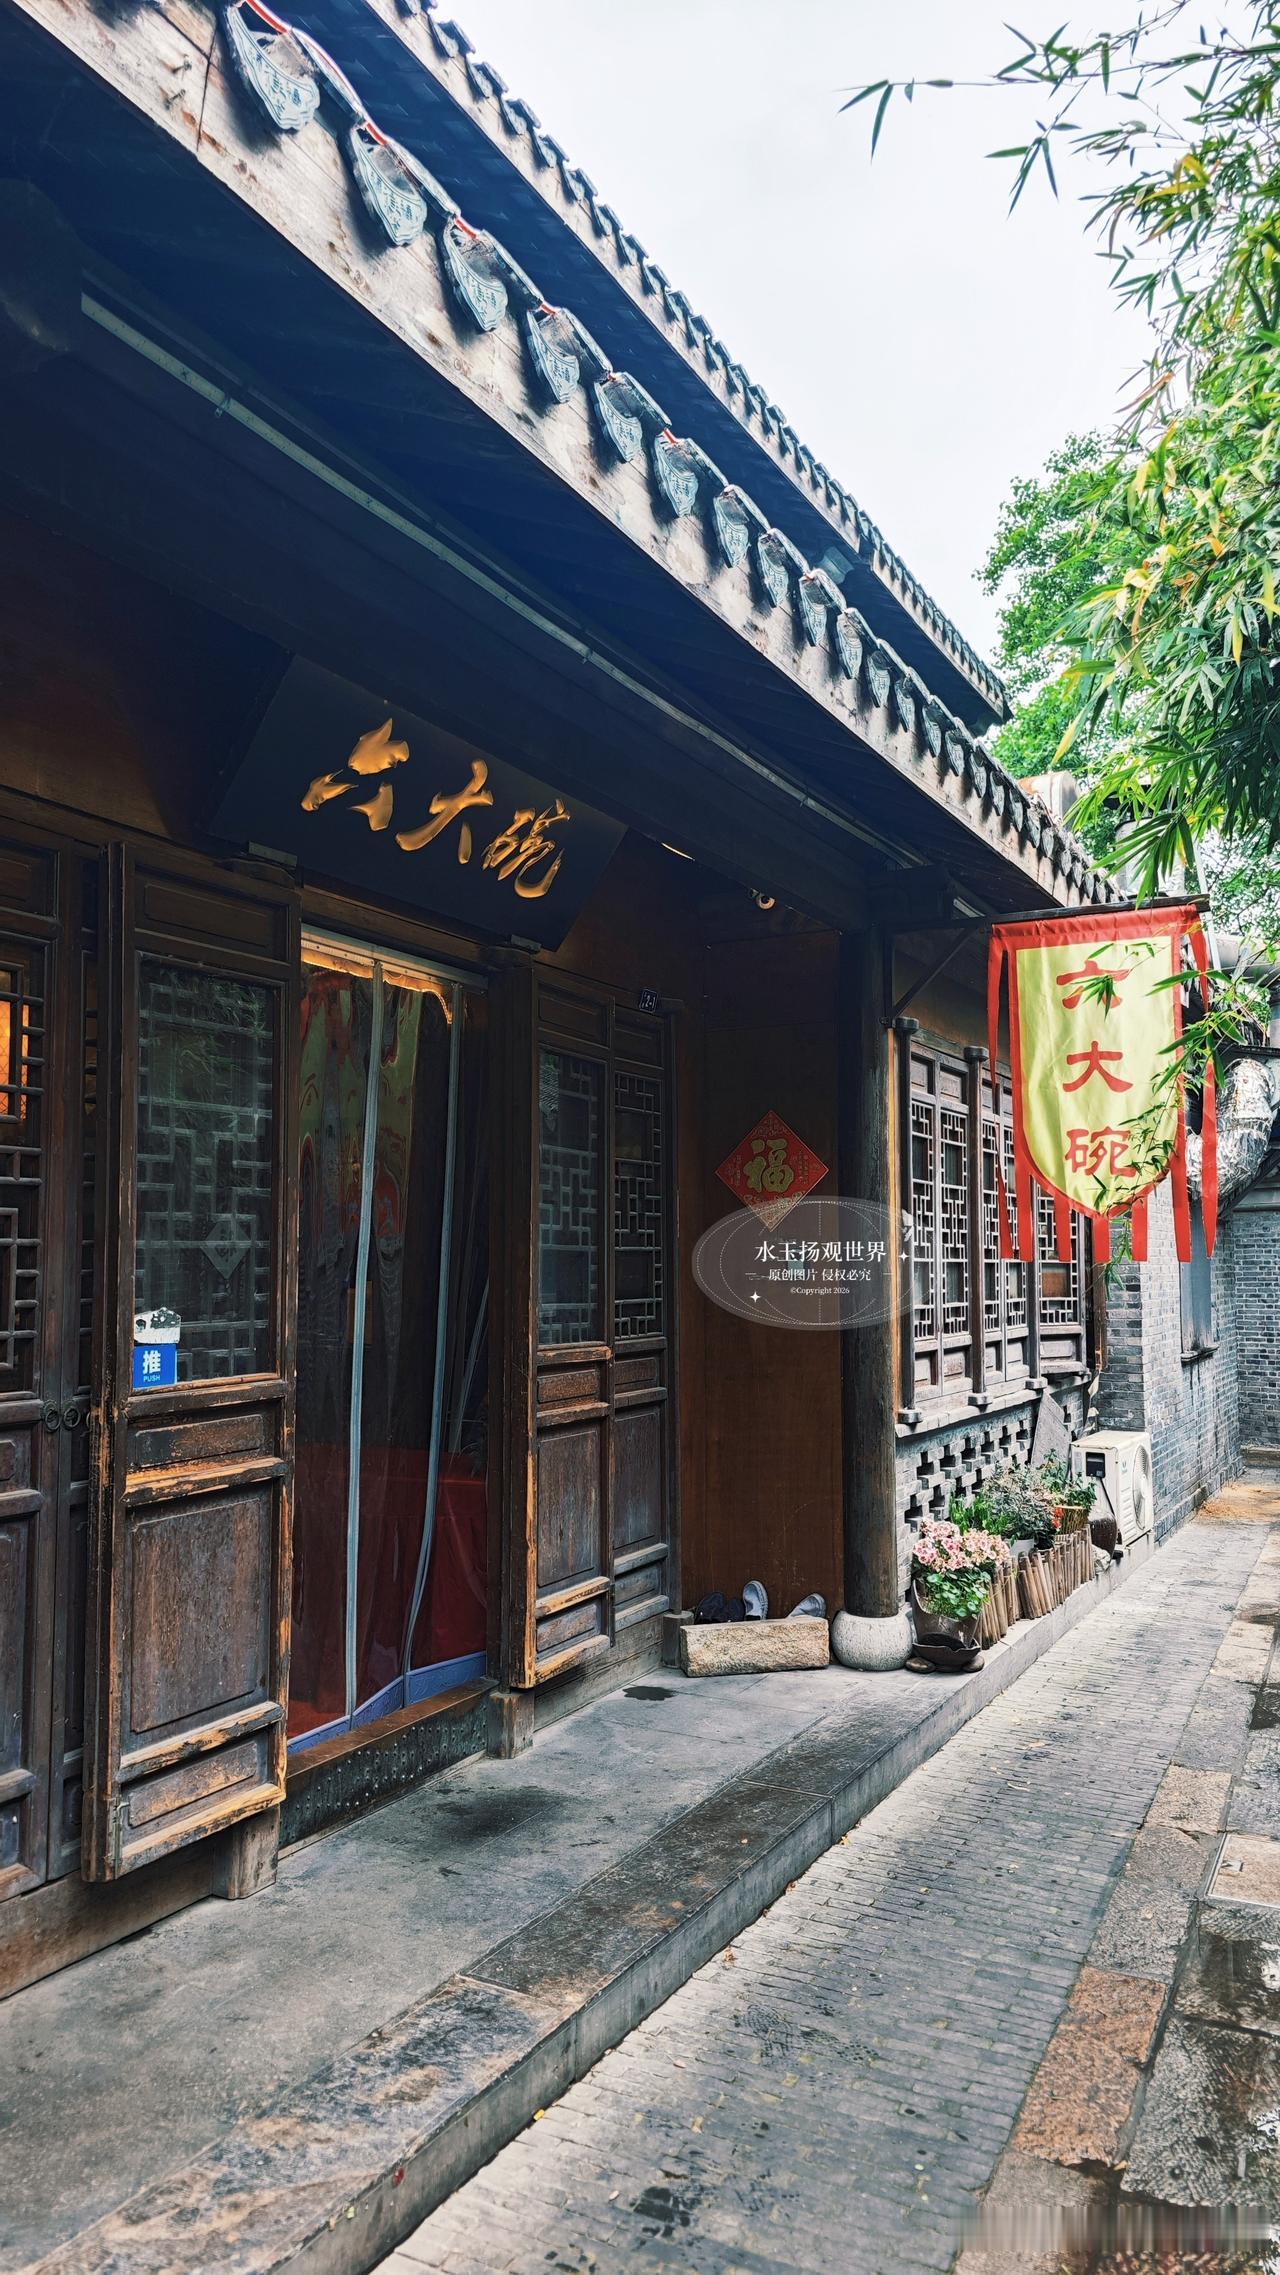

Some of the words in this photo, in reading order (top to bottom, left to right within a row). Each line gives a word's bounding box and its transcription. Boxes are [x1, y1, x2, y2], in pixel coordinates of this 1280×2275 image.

[301, 718, 571, 898] 六大碗
[1056, 960, 1138, 1177] 六大碗
[743, 1138, 794, 1193] 福
[143, 1350, 161, 1374] 推
[143, 1374, 161, 1382] PUSH
